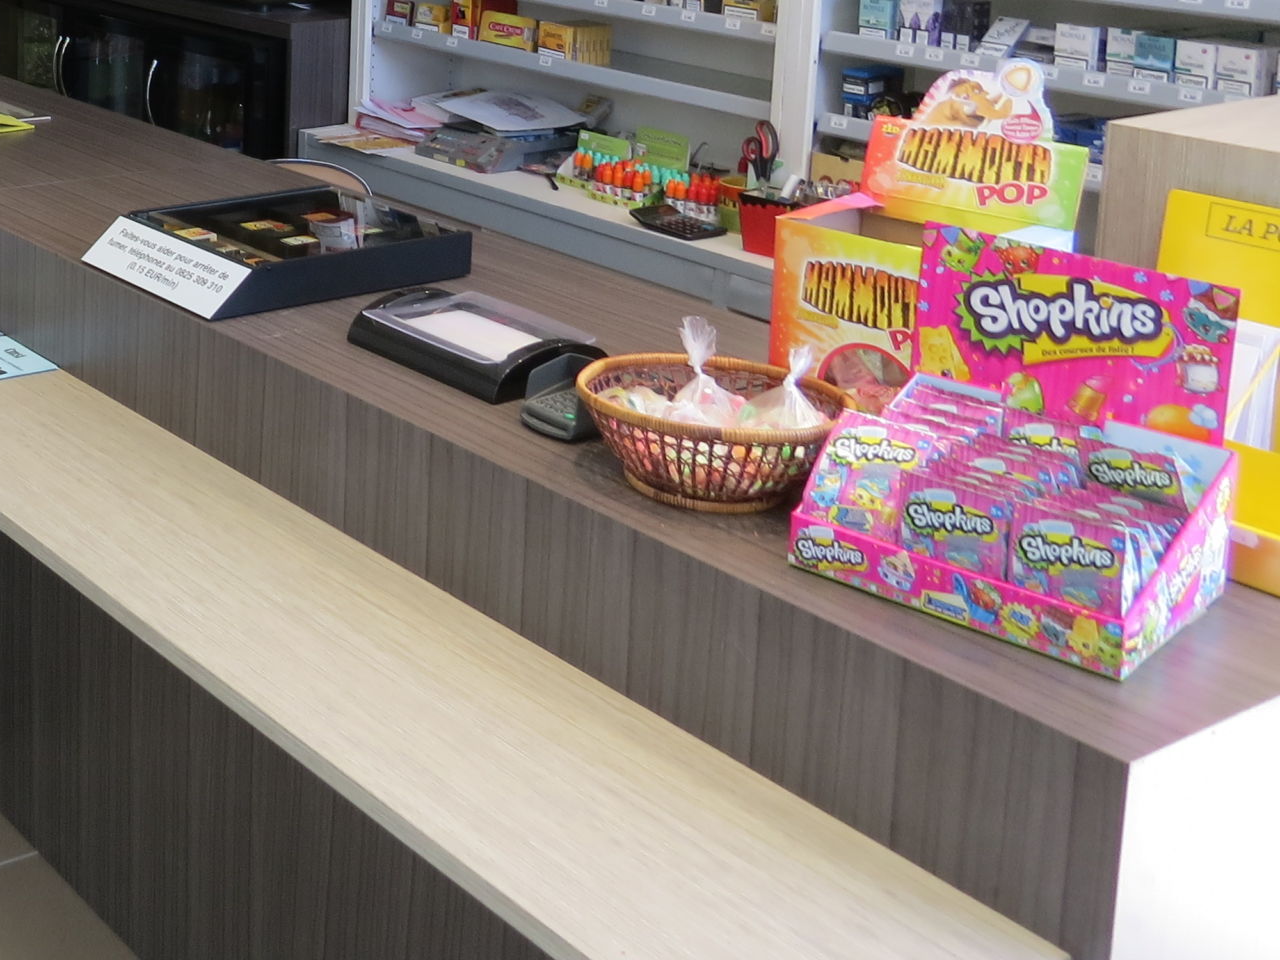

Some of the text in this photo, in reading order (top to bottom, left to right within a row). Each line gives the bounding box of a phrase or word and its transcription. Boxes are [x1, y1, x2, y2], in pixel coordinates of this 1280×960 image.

[1135, 69, 1165, 81] Fumer
[1176, 76, 1206, 88] Fumer
[898, 127, 1052, 186] MAMMOUTH
[975, 181, 1050, 208] POP
[1222, 213, 1280, 243] LA P
[120, 227, 158, 250] Faites-vous
[156, 241, 176, 258] aider
[175, 251, 194, 267] pour
[218, 269, 230, 281] de
[144, 268, 181, 290] EUR/min)
[165, 263, 175, 273] au
[174, 266, 194, 282] 0825
[193, 275, 208, 288] 309
[207, 280, 224, 294] 310
[803, 260, 918, 330] MAMMOUT
[969, 282, 1158, 340] Shopkins
[834, 436, 917, 464] Shopkins
[1089, 459, 1174, 490] Shopkins
[906, 501, 995, 536] Shopkins
[795, 537, 865, 566] Shopkins
[1020, 534, 1115, 569] Shopkins
